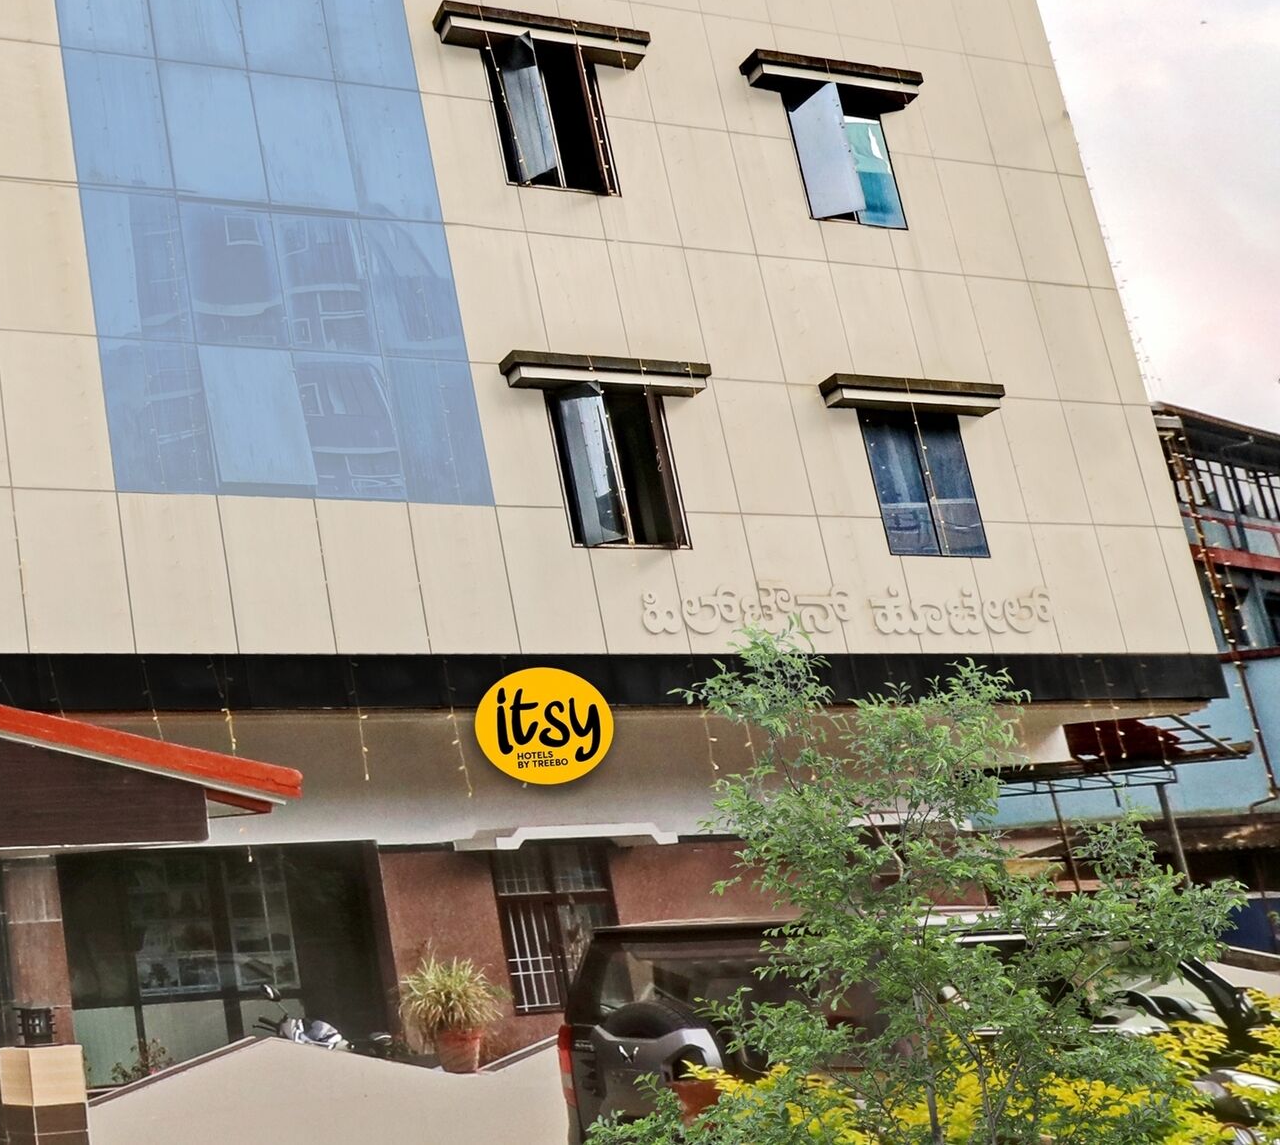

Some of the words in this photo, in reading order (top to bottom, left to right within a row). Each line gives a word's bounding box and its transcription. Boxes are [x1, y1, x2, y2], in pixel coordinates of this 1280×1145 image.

[496, 687, 601, 762] itsy
[517, 750, 554, 760] HOTELS
[517, 760, 530, 769] BY
[533, 758, 569, 768] TREEBO
